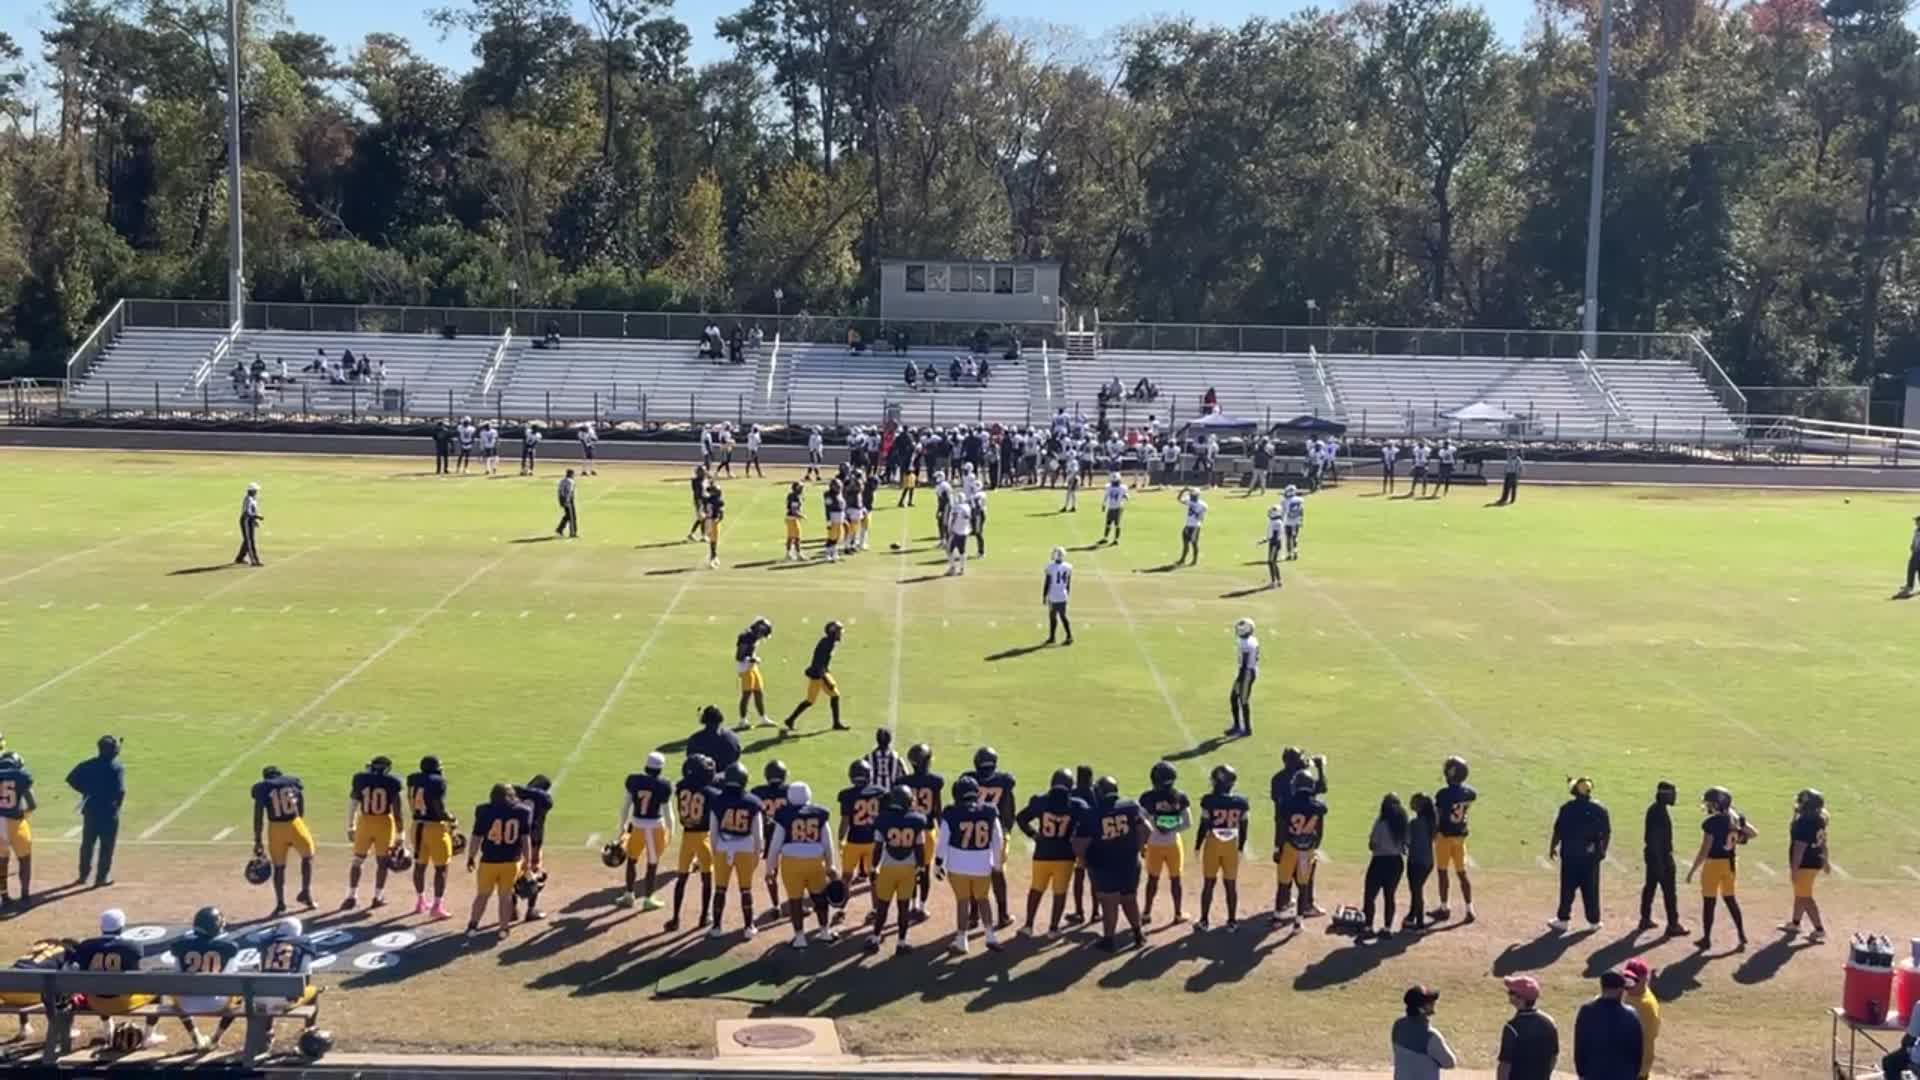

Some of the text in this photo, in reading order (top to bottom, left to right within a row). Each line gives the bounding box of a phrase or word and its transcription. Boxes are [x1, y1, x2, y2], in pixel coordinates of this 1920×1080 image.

[1056, 569, 1068, 585] 14
[361, 787, 388, 815] 10
[638, 789, 653, 816] 7
[679, 788, 704, 820] 38
[486, 818, 520, 845] 40
[720, 808, 750, 832] 46
[1041, 810, 1071, 838] 57
[959, 820, 990, 849] 76
